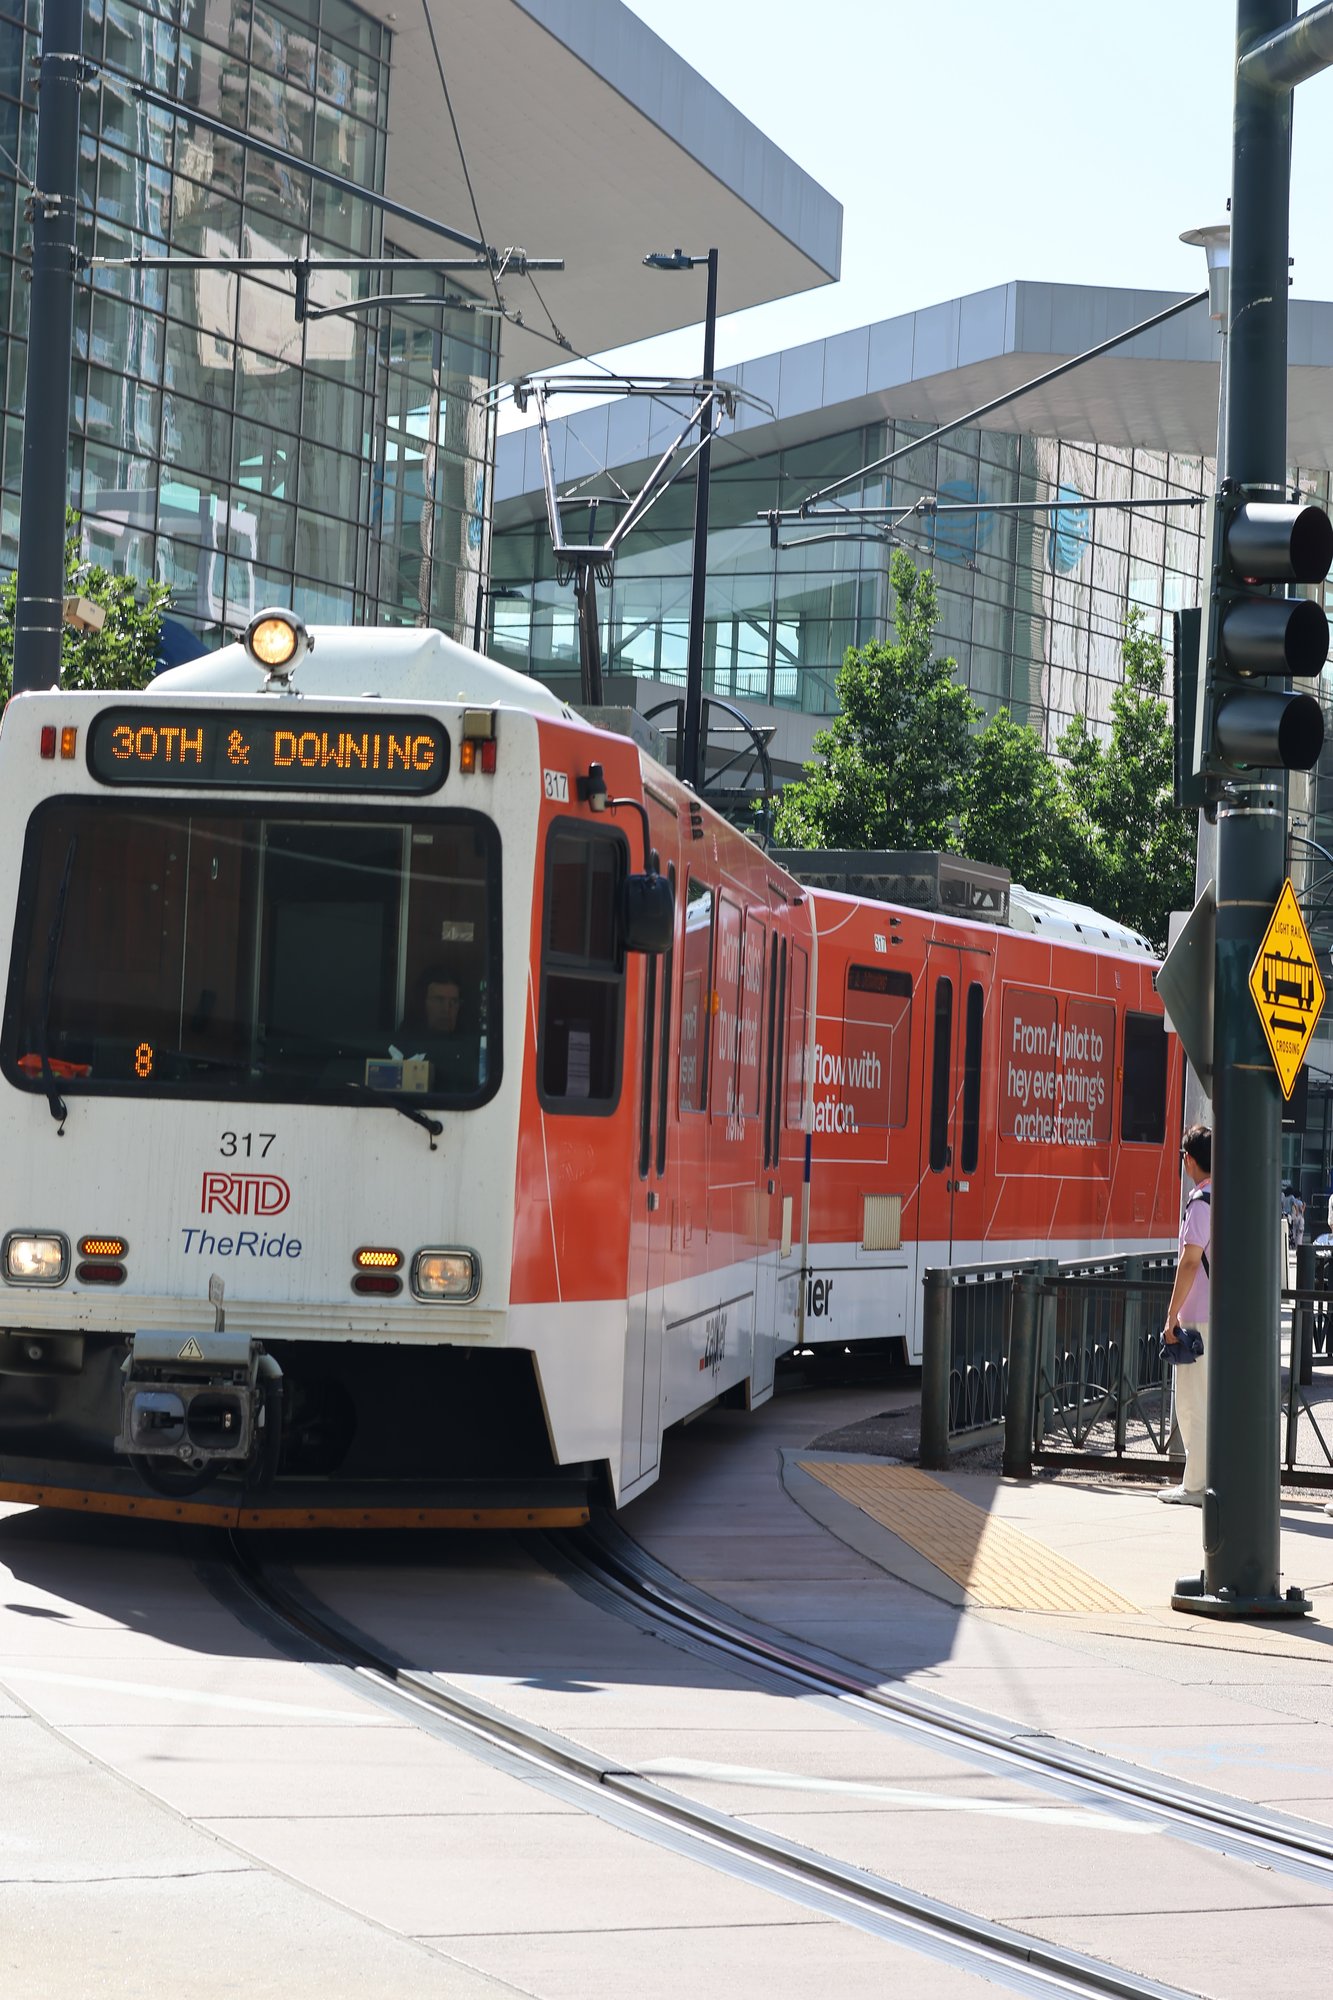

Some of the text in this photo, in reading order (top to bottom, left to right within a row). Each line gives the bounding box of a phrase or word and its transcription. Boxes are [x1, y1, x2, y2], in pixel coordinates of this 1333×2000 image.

[112, 726, 435, 771] 30TH & DOWNING
[545, 772, 567, 799] 317
[1274, 921, 1303, 939] LIGHT RAIL
[135, 1042, 153, 1078] 8
[1013, 1016, 1047, 1056] From
[1063, 1024, 1089, 1066] pilot
[1090, 1028, 1103, 1063] to
[1275, 1039, 1301, 1055] CROSSING
[847, 1050, 881, 1089] with
[1007, 1060, 1105, 1112] hey everything's
[219, 1131, 277, 1158] 317
[1014, 1106, 1097, 1147] orchestrated.
[201, 1171, 291, 1217] RTD
[181, 1228, 303, 1259] TheRide
[805, 1265, 833, 1317] ier
